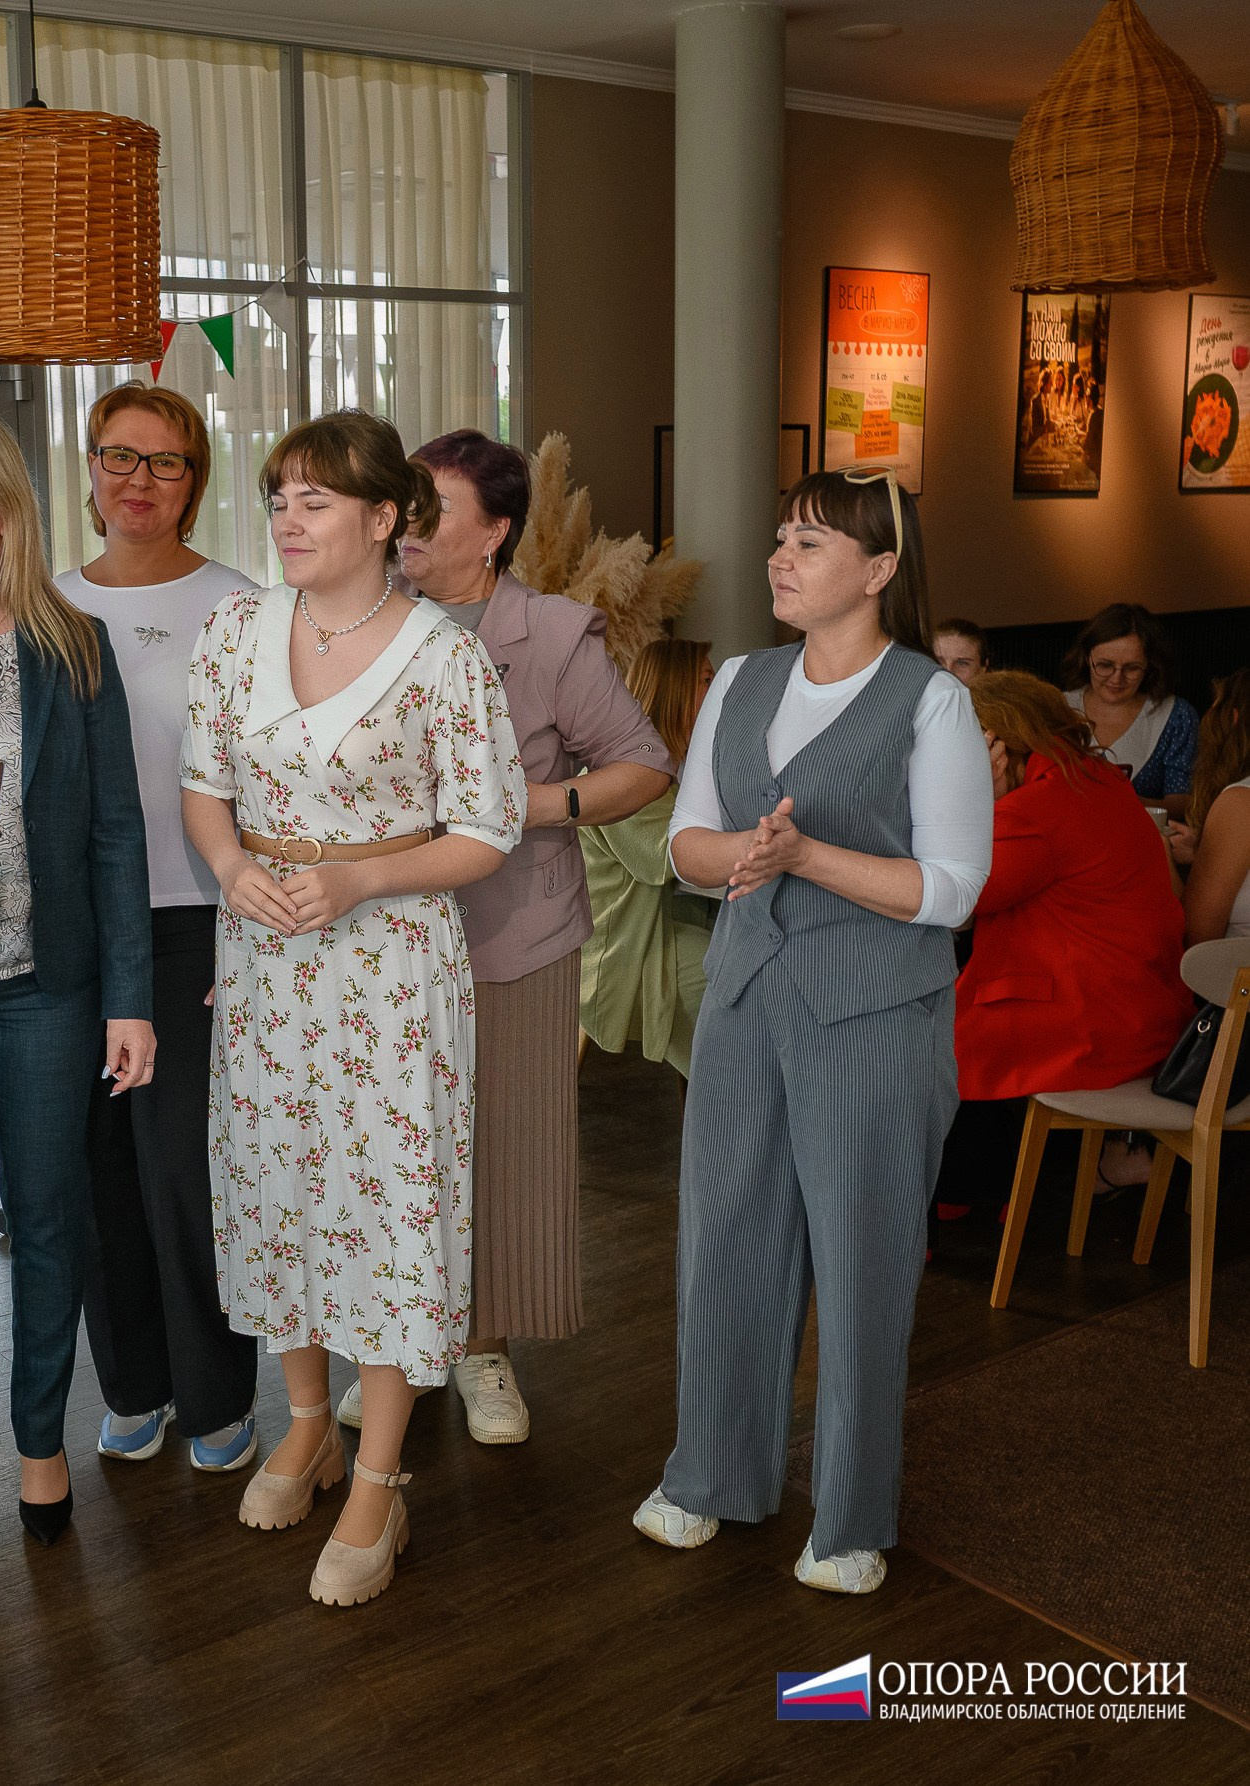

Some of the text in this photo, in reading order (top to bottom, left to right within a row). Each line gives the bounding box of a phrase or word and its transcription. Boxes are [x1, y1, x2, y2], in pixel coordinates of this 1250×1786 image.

[838, 284, 877, 311] ВЕСНА
[1030, 321, 1068, 342] МОЖНО
[1030, 340, 1077, 364] СО СВОИМ
